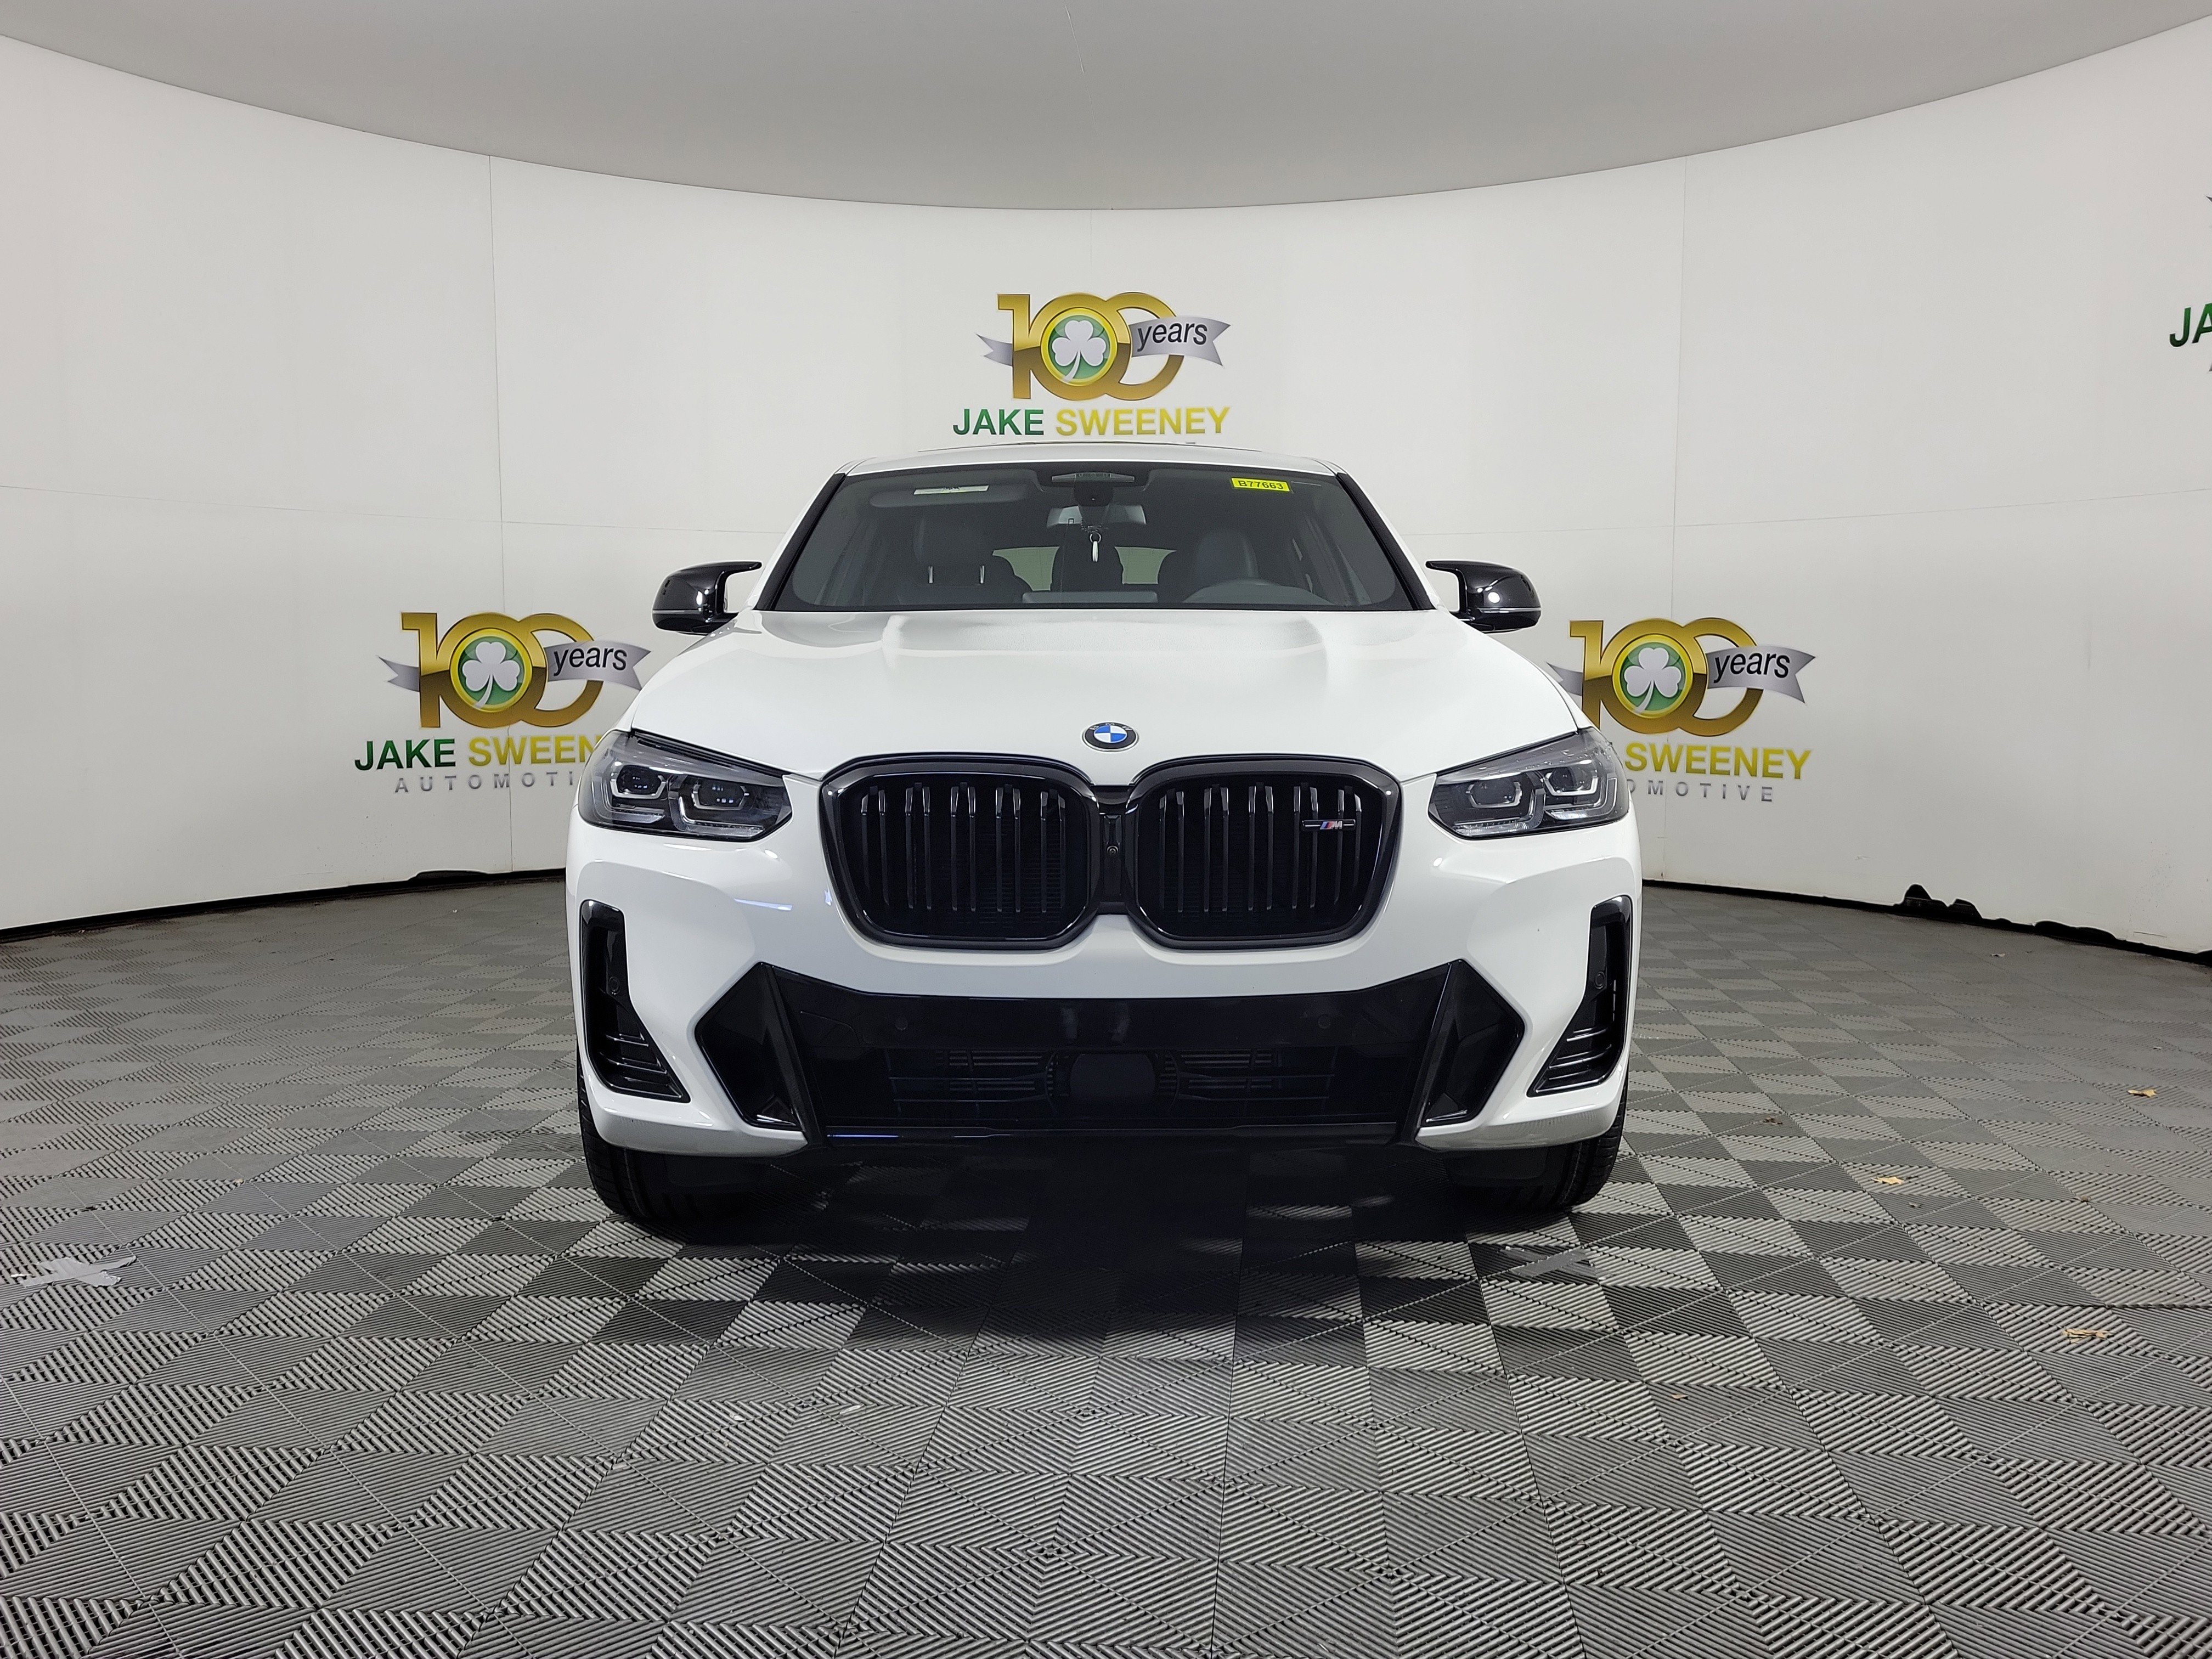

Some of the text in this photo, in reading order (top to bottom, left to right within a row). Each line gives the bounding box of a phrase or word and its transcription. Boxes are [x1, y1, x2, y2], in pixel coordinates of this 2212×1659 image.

[2170, 302, 2212, 347] JA
[996, 292, 1208, 401] 100 years
[952, 406, 1231, 436] JAKE SWEENEY
[1238, 480, 1283, 489] B77663
[400, 612, 627, 728] 100 years
[1570, 617, 1790, 737] 100 years
[354, 735, 602, 770] JAKE SWEEN
[1624, 742, 1811, 780] SWEENEY
[394, 771, 573, 793] AUTOMOTI
